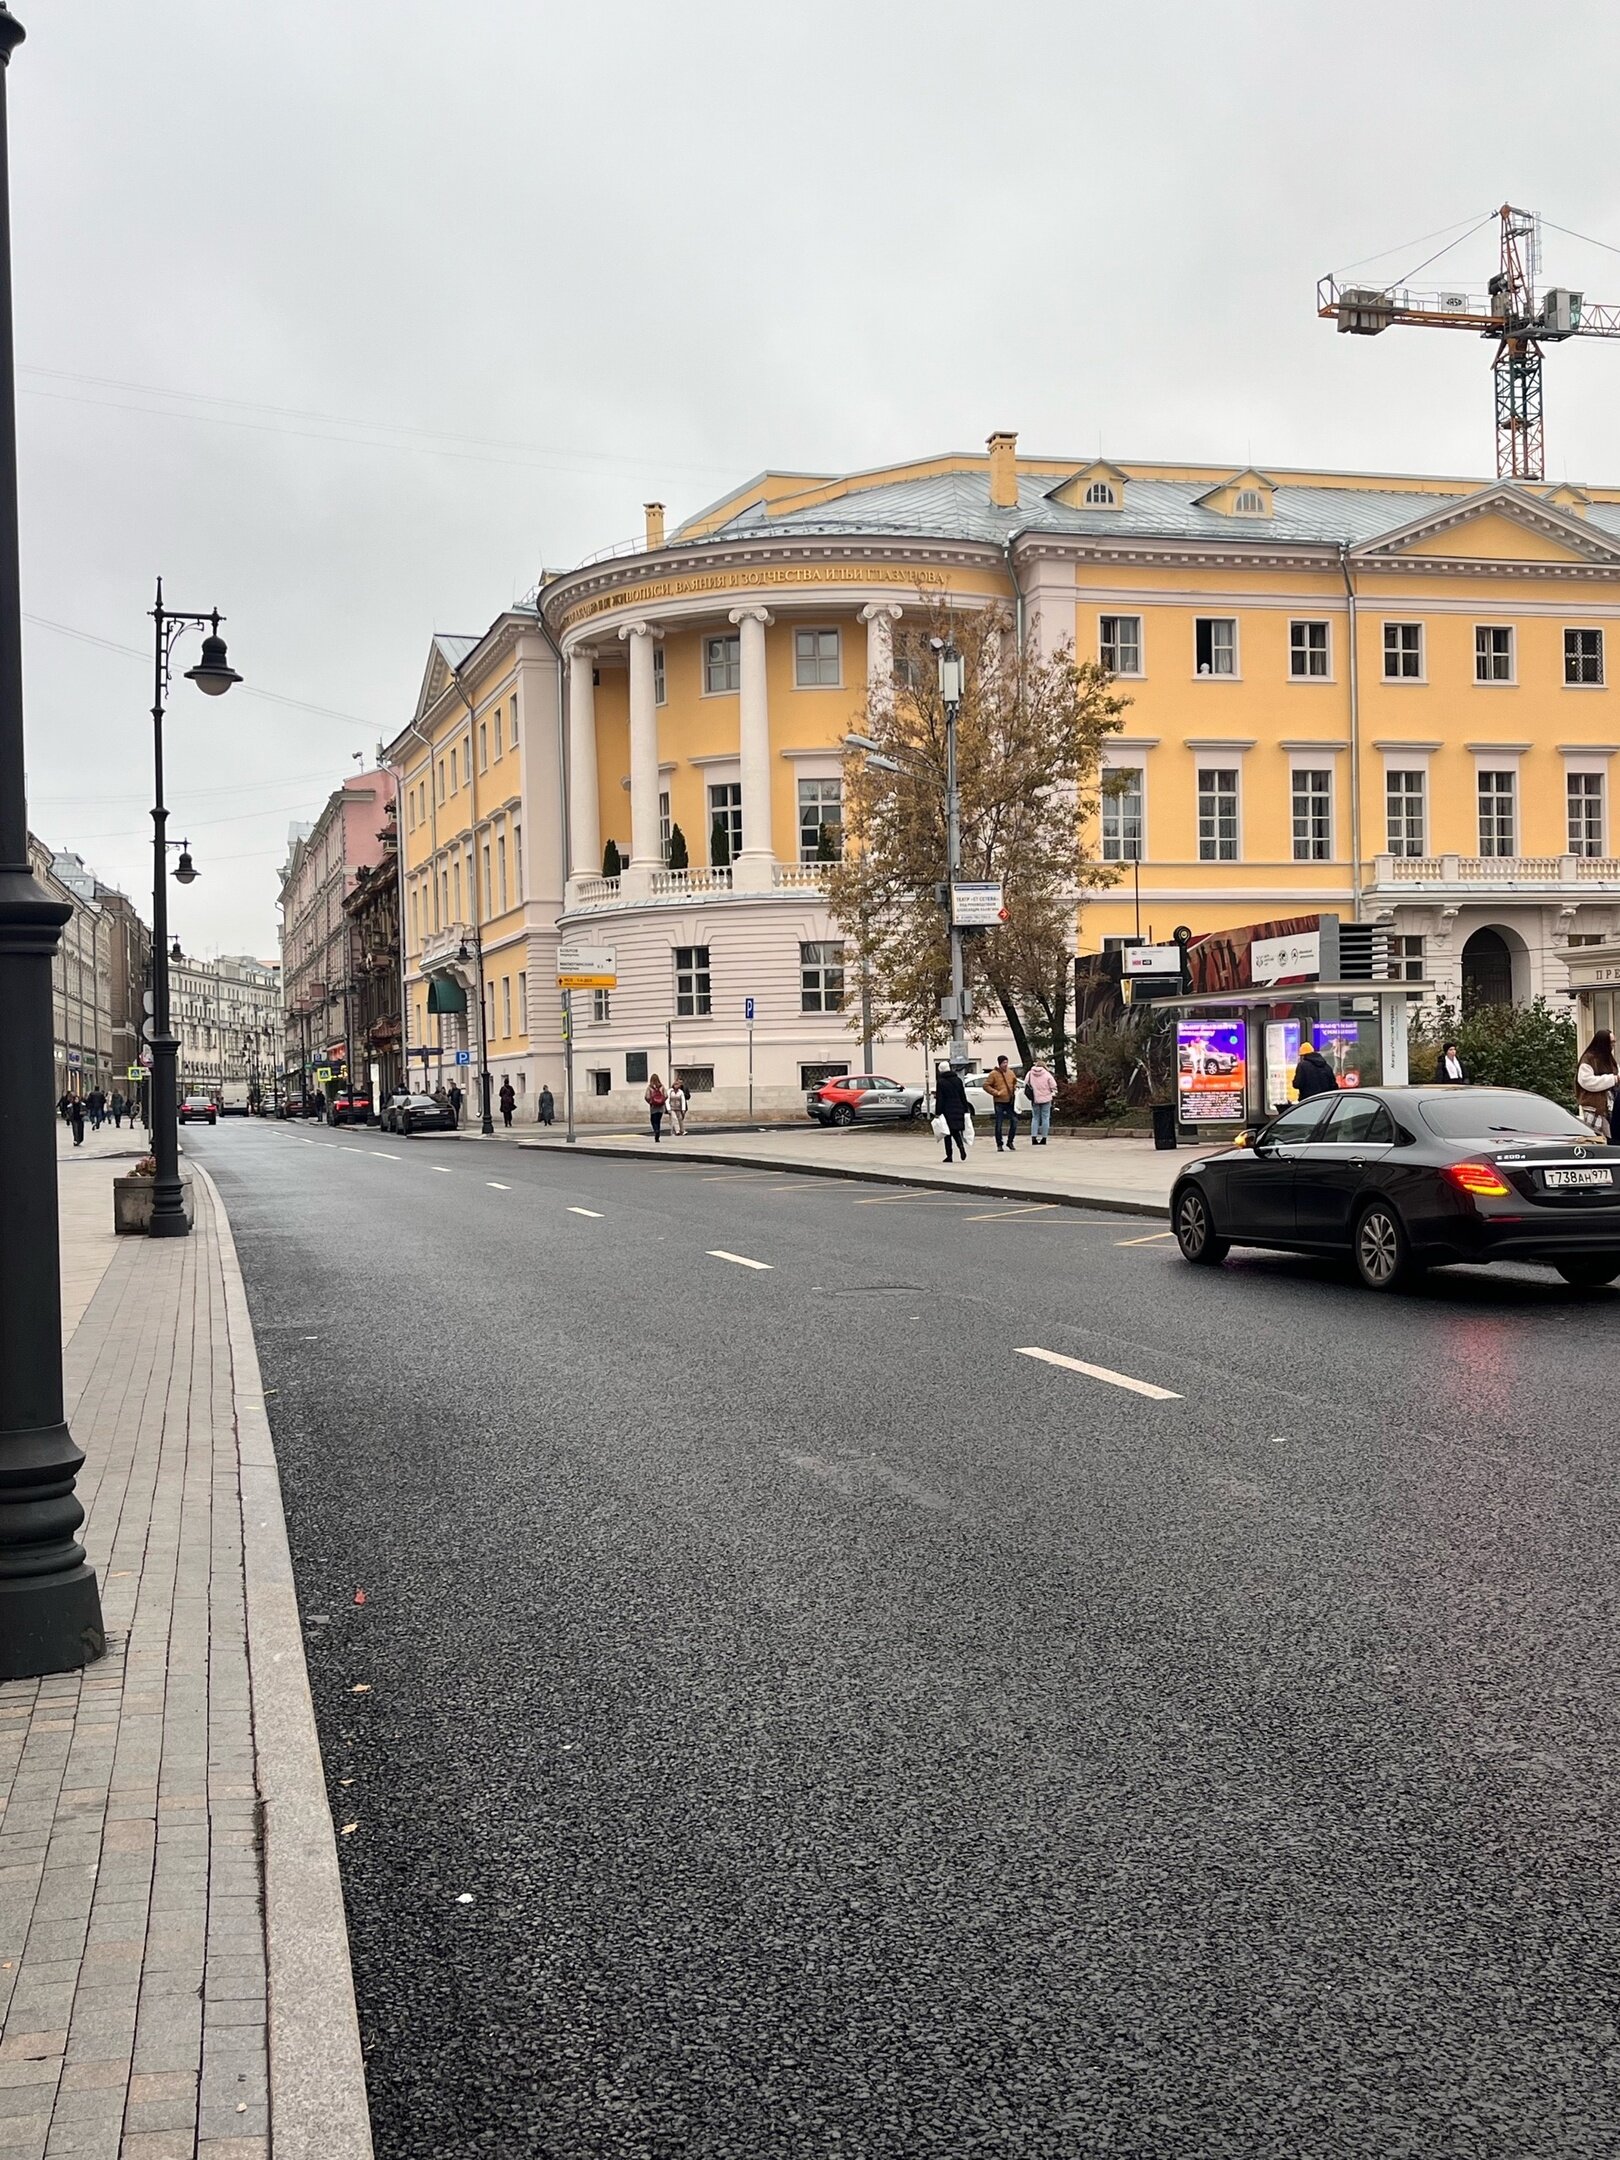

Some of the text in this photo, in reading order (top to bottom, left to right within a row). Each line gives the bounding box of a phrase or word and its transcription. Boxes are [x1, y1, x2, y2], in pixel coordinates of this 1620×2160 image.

[612, 583, 674, 607] ЖИВОПИСИ,
[675, 575, 726, 593] ВАЯНИЯ
[729, 574, 739, 587] И
[742, 569, 821, 585] ЗОДЧЕСТВА
[825, 569, 863, 581] ИЛЬИ
[867, 569, 944, 584] ГЛАЗУНОВА
[1549, 1169, 1608, 1184] Т738АН 977
